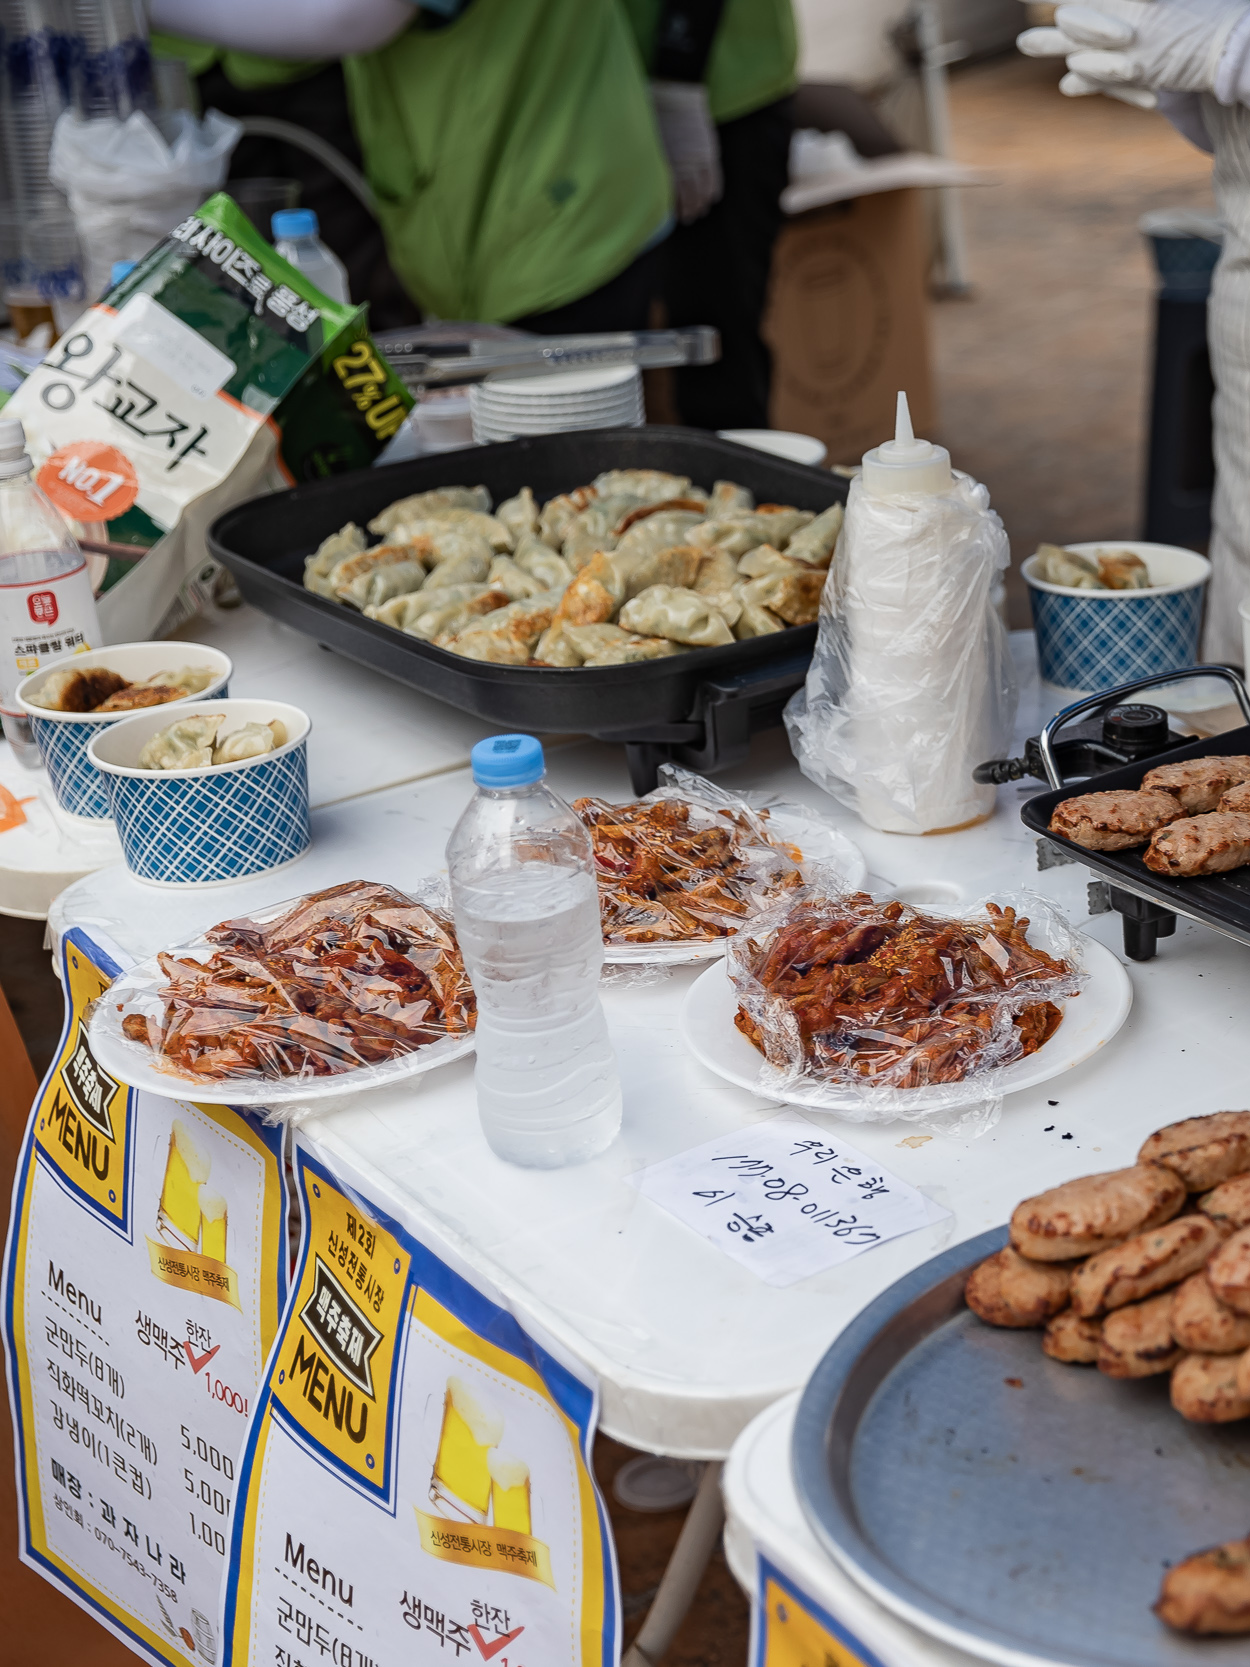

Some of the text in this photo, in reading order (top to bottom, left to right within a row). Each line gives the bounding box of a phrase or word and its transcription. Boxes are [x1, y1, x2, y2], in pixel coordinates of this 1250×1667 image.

[40, 332, 209, 473] 왕교자
[15, 639, 62, 656] 스파클링
[64, 630, 84, 649] 워터
[48, 1087, 109, 1181] MENU
[48, 1259, 102, 1326] Menu
[158, 1256, 200, 1282] 신성전통시장
[328, 1229, 384, 1314] 신성전통시장
[45, 1315, 125, 1399] 군만두(8개)
[135, 1309, 186, 1370] 생맥주
[185, 1318, 212, 1354] 한잔
[315, 1284, 366, 1367] 맥주축제
[204, 1371, 249, 1418] 1,000!
[288, 1334, 368, 1444] MENU
[51, 1457, 82, 1500] 매장
[180, 1423, 234, 1481] 5,000
[285, 1531, 354, 1608] Menu
[430, 1530, 538, 1567] 신성전통시장 맥주축제
[399, 1590, 471, 1657] 생맥주
[470, 1598, 511, 1638] 한잔
